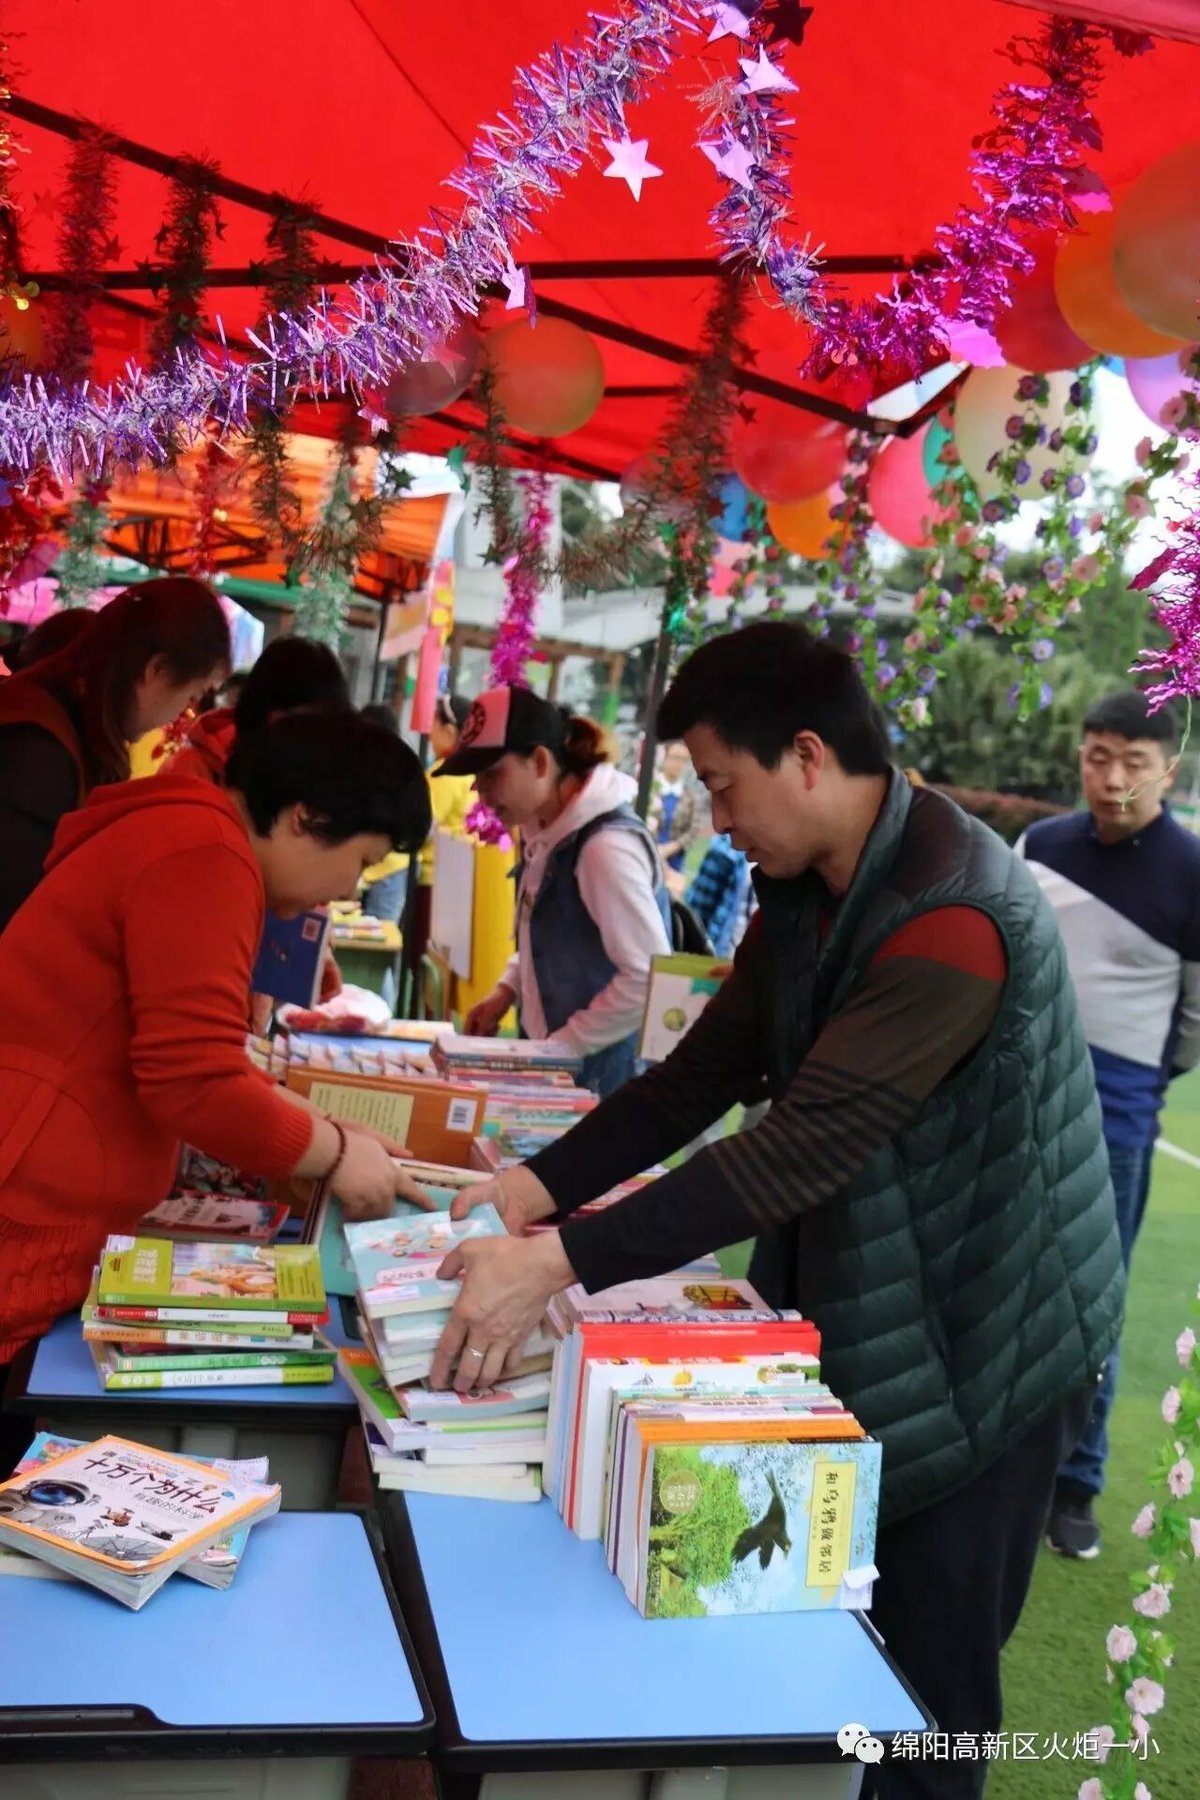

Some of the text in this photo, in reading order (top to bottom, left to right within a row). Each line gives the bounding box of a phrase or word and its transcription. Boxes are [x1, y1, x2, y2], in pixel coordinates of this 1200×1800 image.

[84, 1457, 221, 1514] 十万个为什么
[817, 1471, 840, 1574] 和乌鸦做邻居
